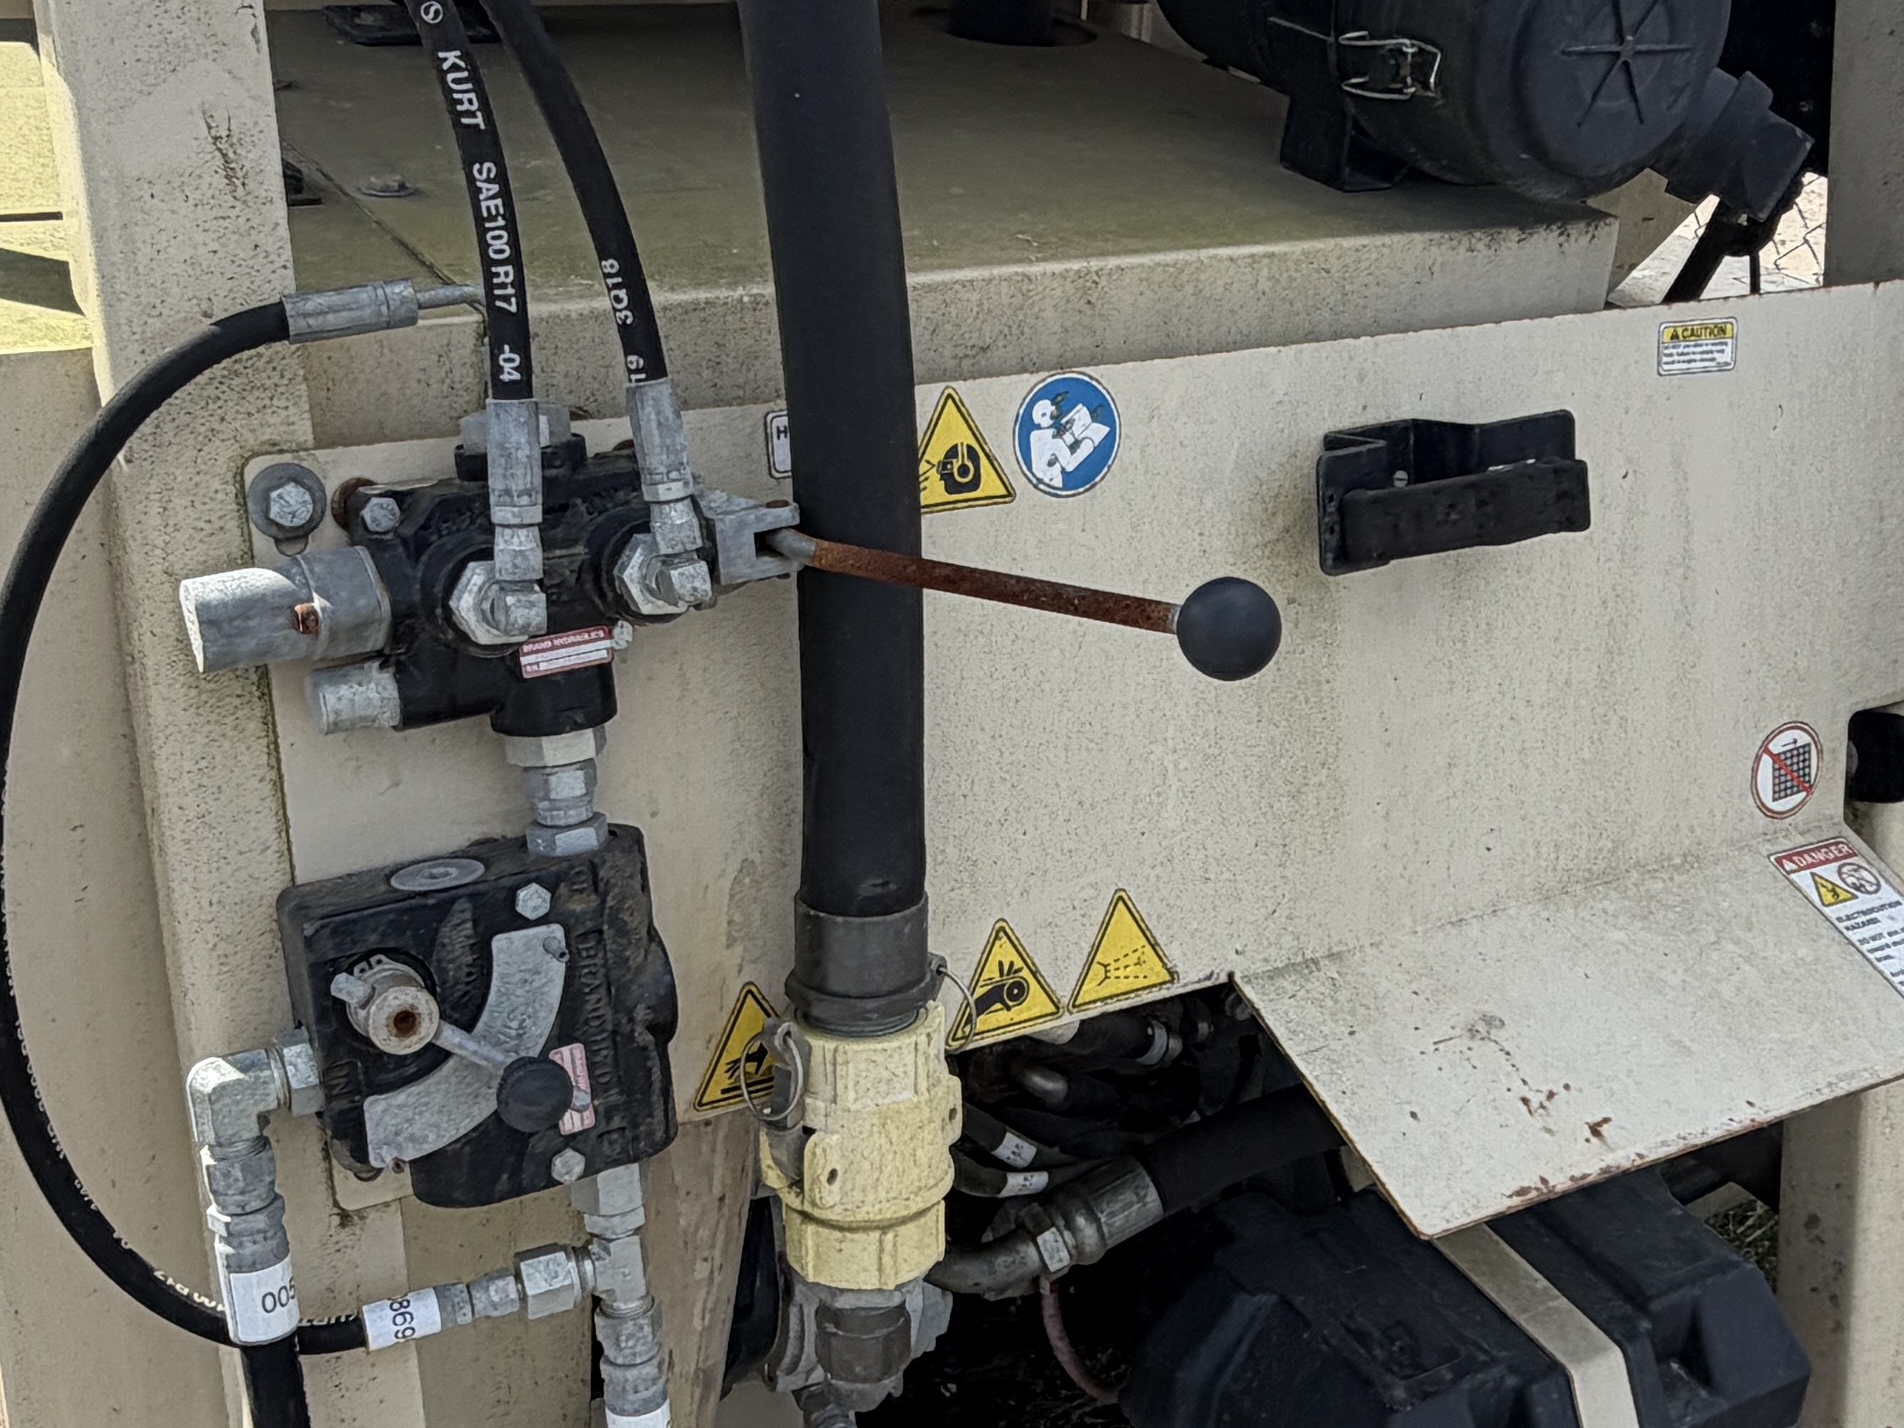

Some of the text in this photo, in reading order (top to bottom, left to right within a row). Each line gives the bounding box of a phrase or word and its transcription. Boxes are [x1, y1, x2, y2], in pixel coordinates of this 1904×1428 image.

[437, 48, 487, 132] KURT
[472, 160, 511, 262] SAE100
[490, 264, 518, 316] R17
[600, 257, 635, 327] 3Q18
[1681, 324, 1727, 339] CAUTION
[498, 344, 522, 384] -04
[1793, 843, 1856, 869] DANGER
